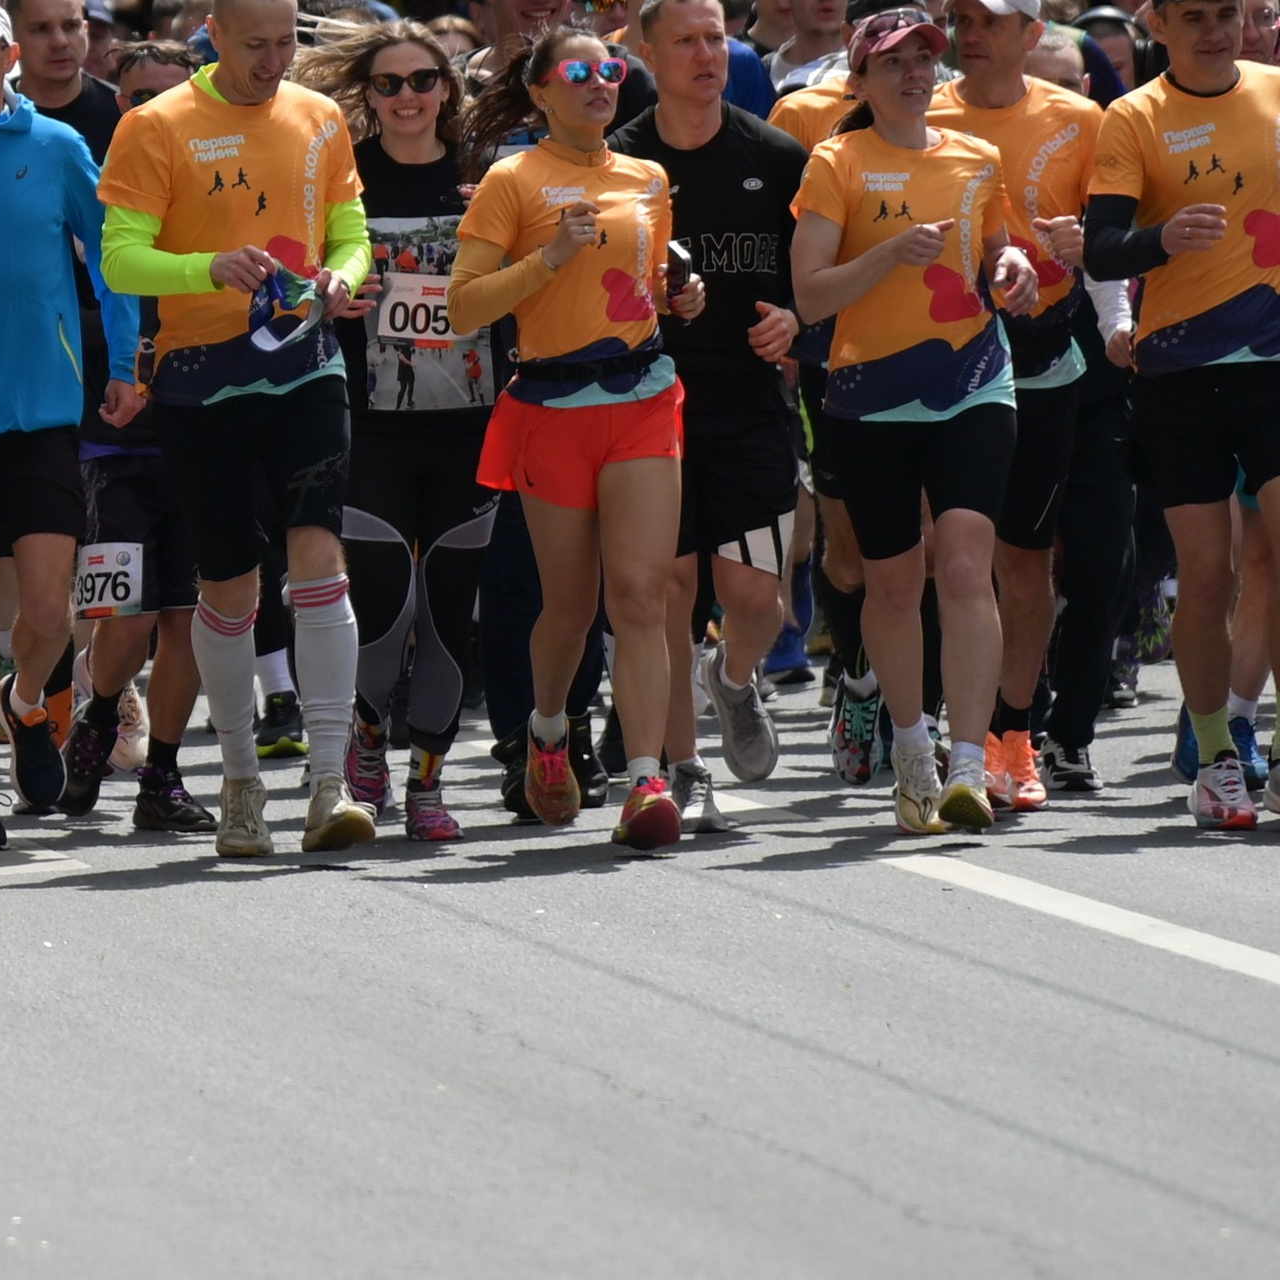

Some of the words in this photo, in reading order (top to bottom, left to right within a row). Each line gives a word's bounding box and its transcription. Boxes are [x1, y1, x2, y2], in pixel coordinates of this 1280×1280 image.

[189, 134, 245, 152] Первая
[1163, 123, 1216, 144] Первая
[1168, 135, 1211, 154] линия
[194, 147, 239, 163] линия
[861, 171, 910, 184] Первая
[701, 233, 779, 273] MORE
[388, 301, 451, 335] 005
[77, 571, 130, 606] 3976
